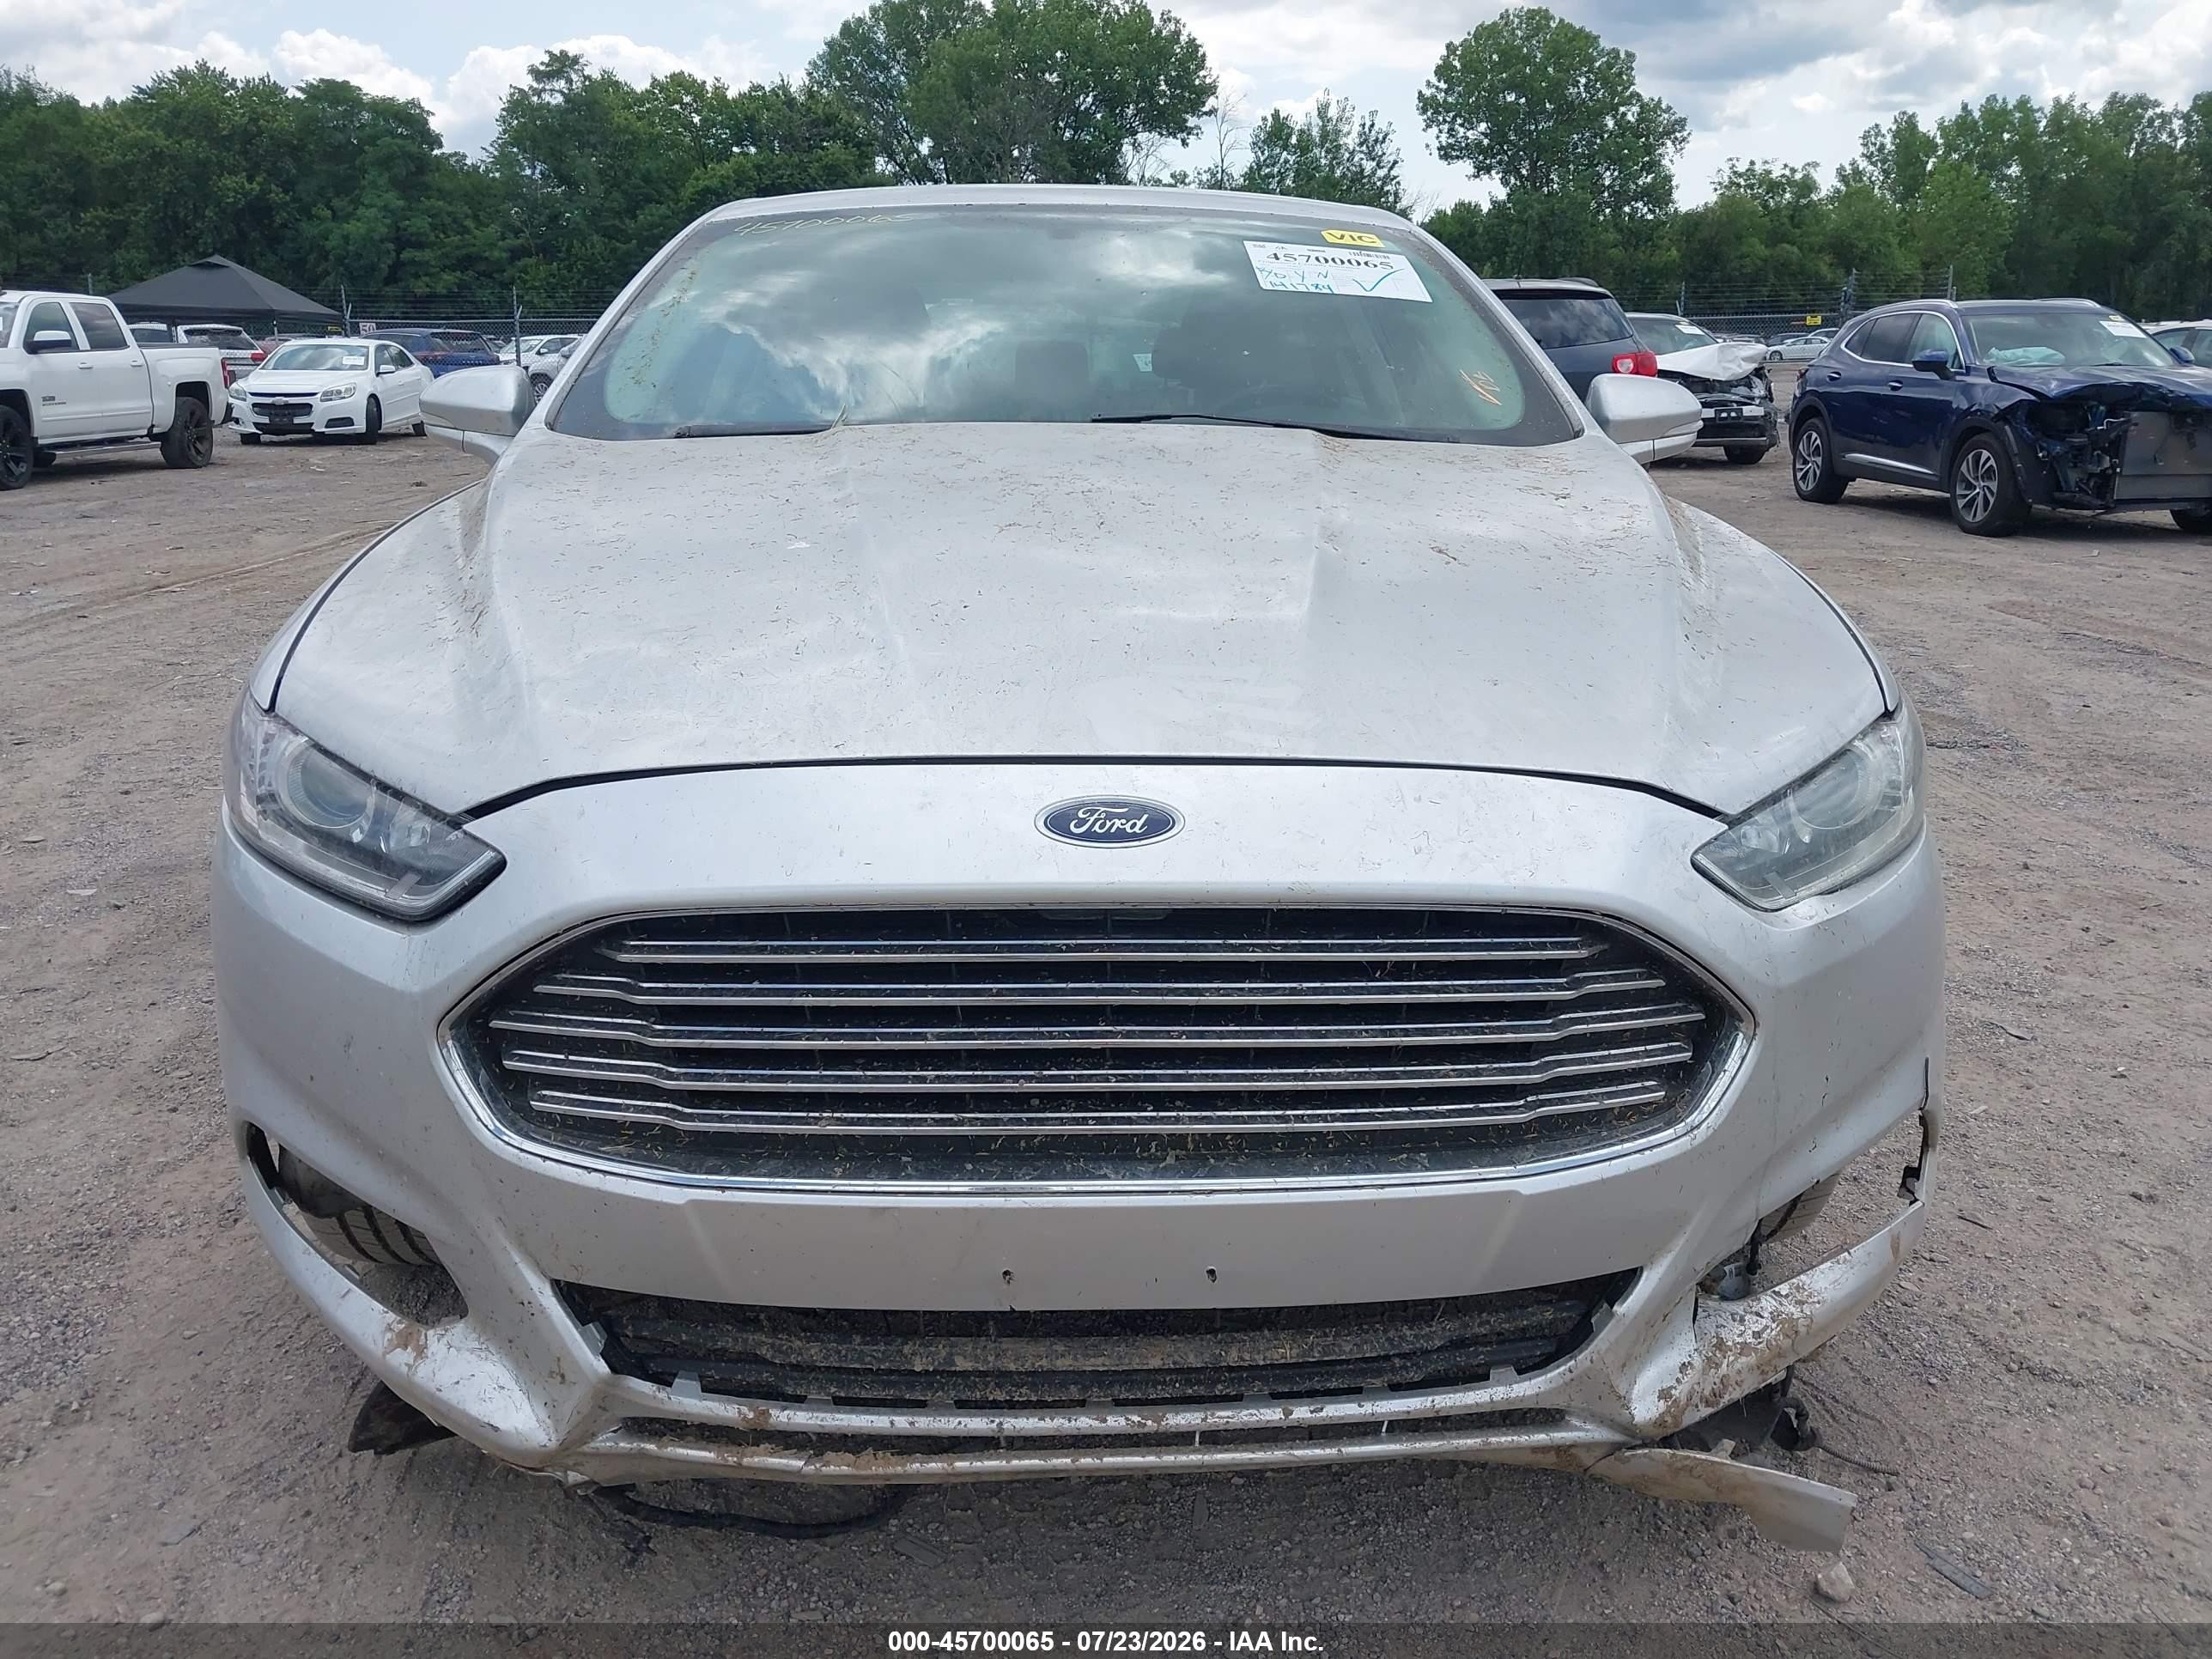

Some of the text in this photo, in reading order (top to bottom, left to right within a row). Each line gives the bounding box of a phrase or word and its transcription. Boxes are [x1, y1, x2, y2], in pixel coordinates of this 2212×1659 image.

[735, 214, 915, 236] 45700065
[1326, 231, 1377, 244] VIC
[1266, 252, 1395, 270] 45700065
[1069, 806, 1148, 835] Ford
